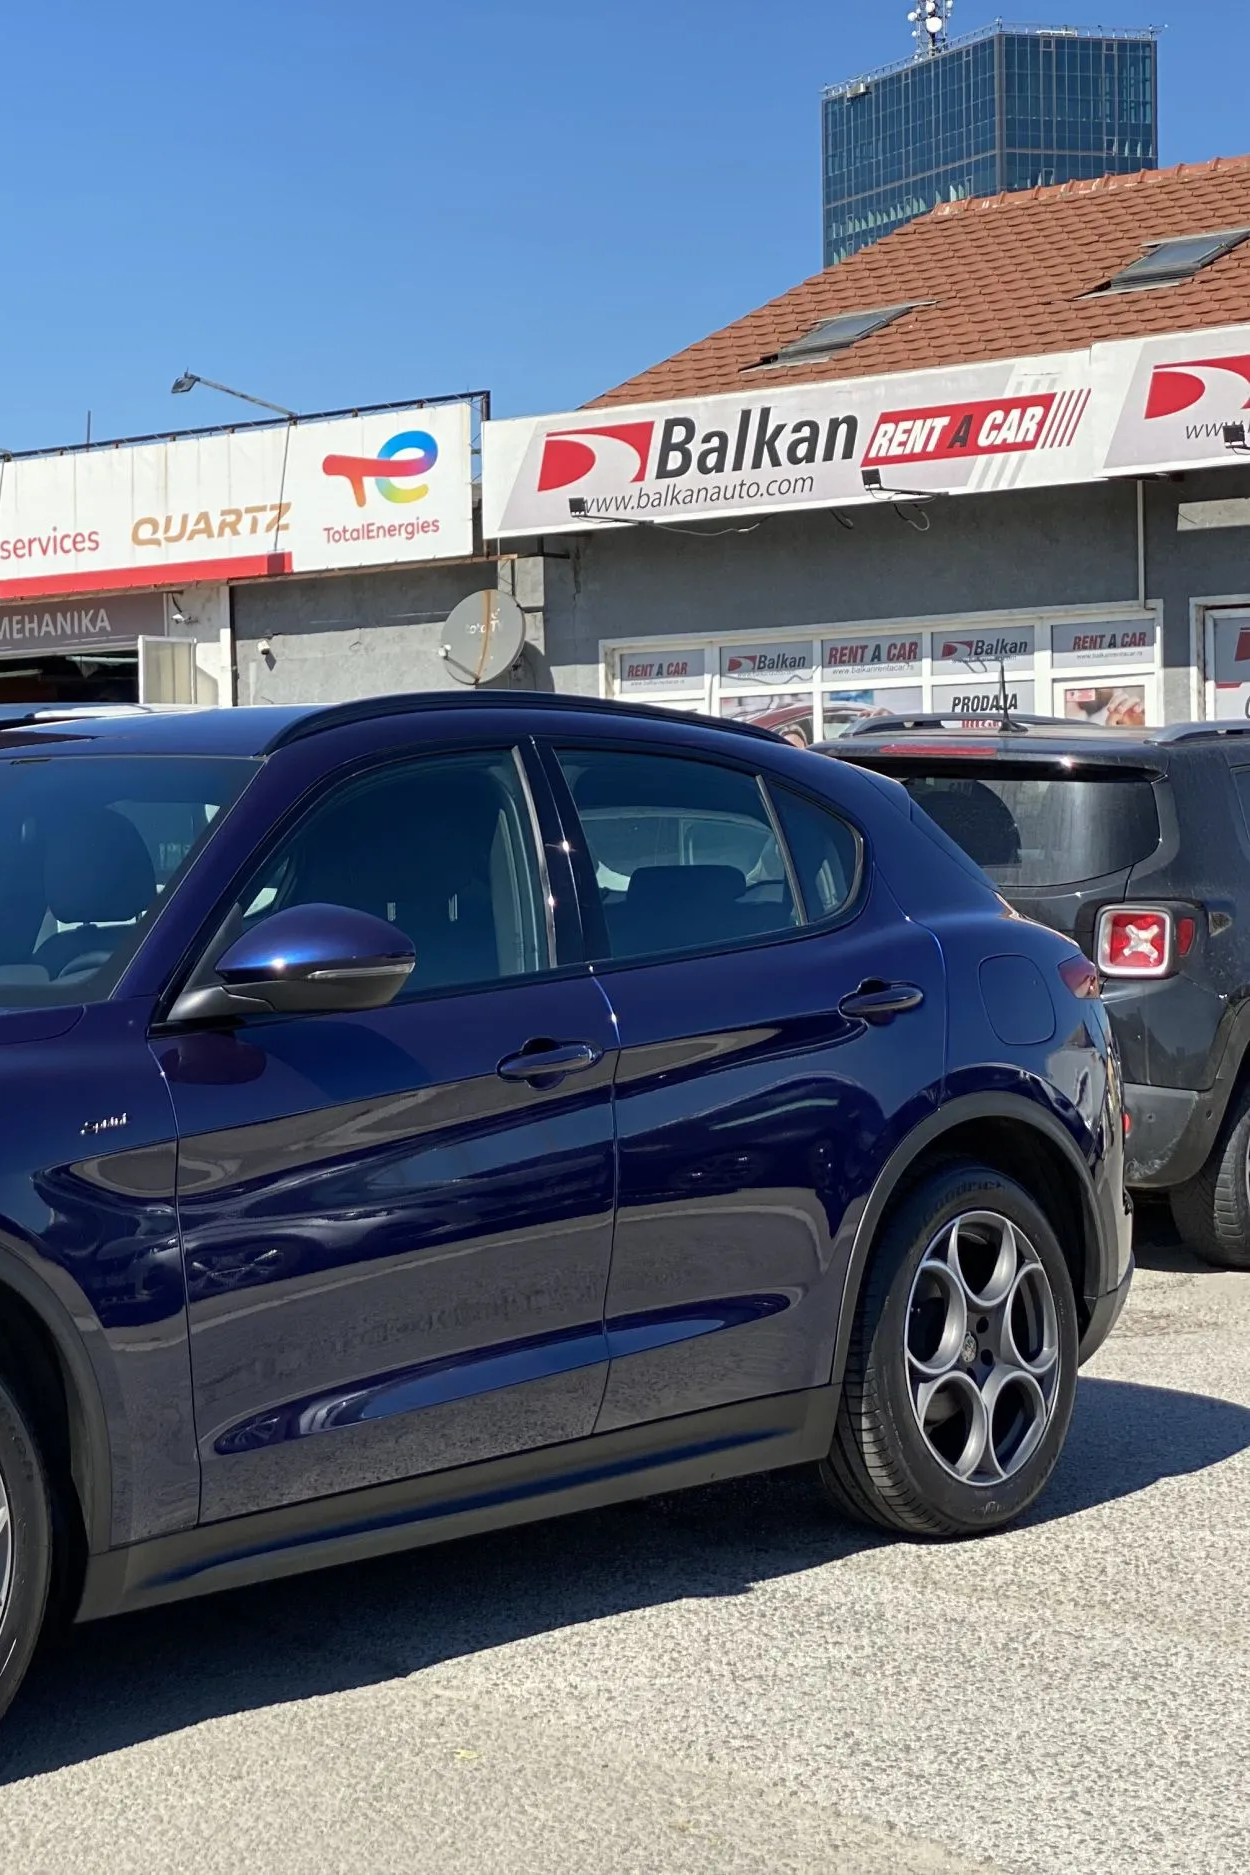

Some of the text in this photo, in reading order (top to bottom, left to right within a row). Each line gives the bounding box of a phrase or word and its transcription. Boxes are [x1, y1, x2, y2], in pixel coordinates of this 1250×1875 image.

[655, 404, 1045, 481] Balkan RENT A CAR
[131, 502, 292, 547] QUARTZ
[323, 516, 440, 544] TotalEnergies
[0, 526, 100, 561] services
[973, 638, 1028, 656] Balkan
[1073, 632, 1147, 650] RENT A CAR
[756, 653, 806, 671] Balkan
[828, 641, 919, 665] RENT A CAR
[628, 661, 688, 677] RENT A CAR
[952, 693, 1018, 713] PRODAJA
